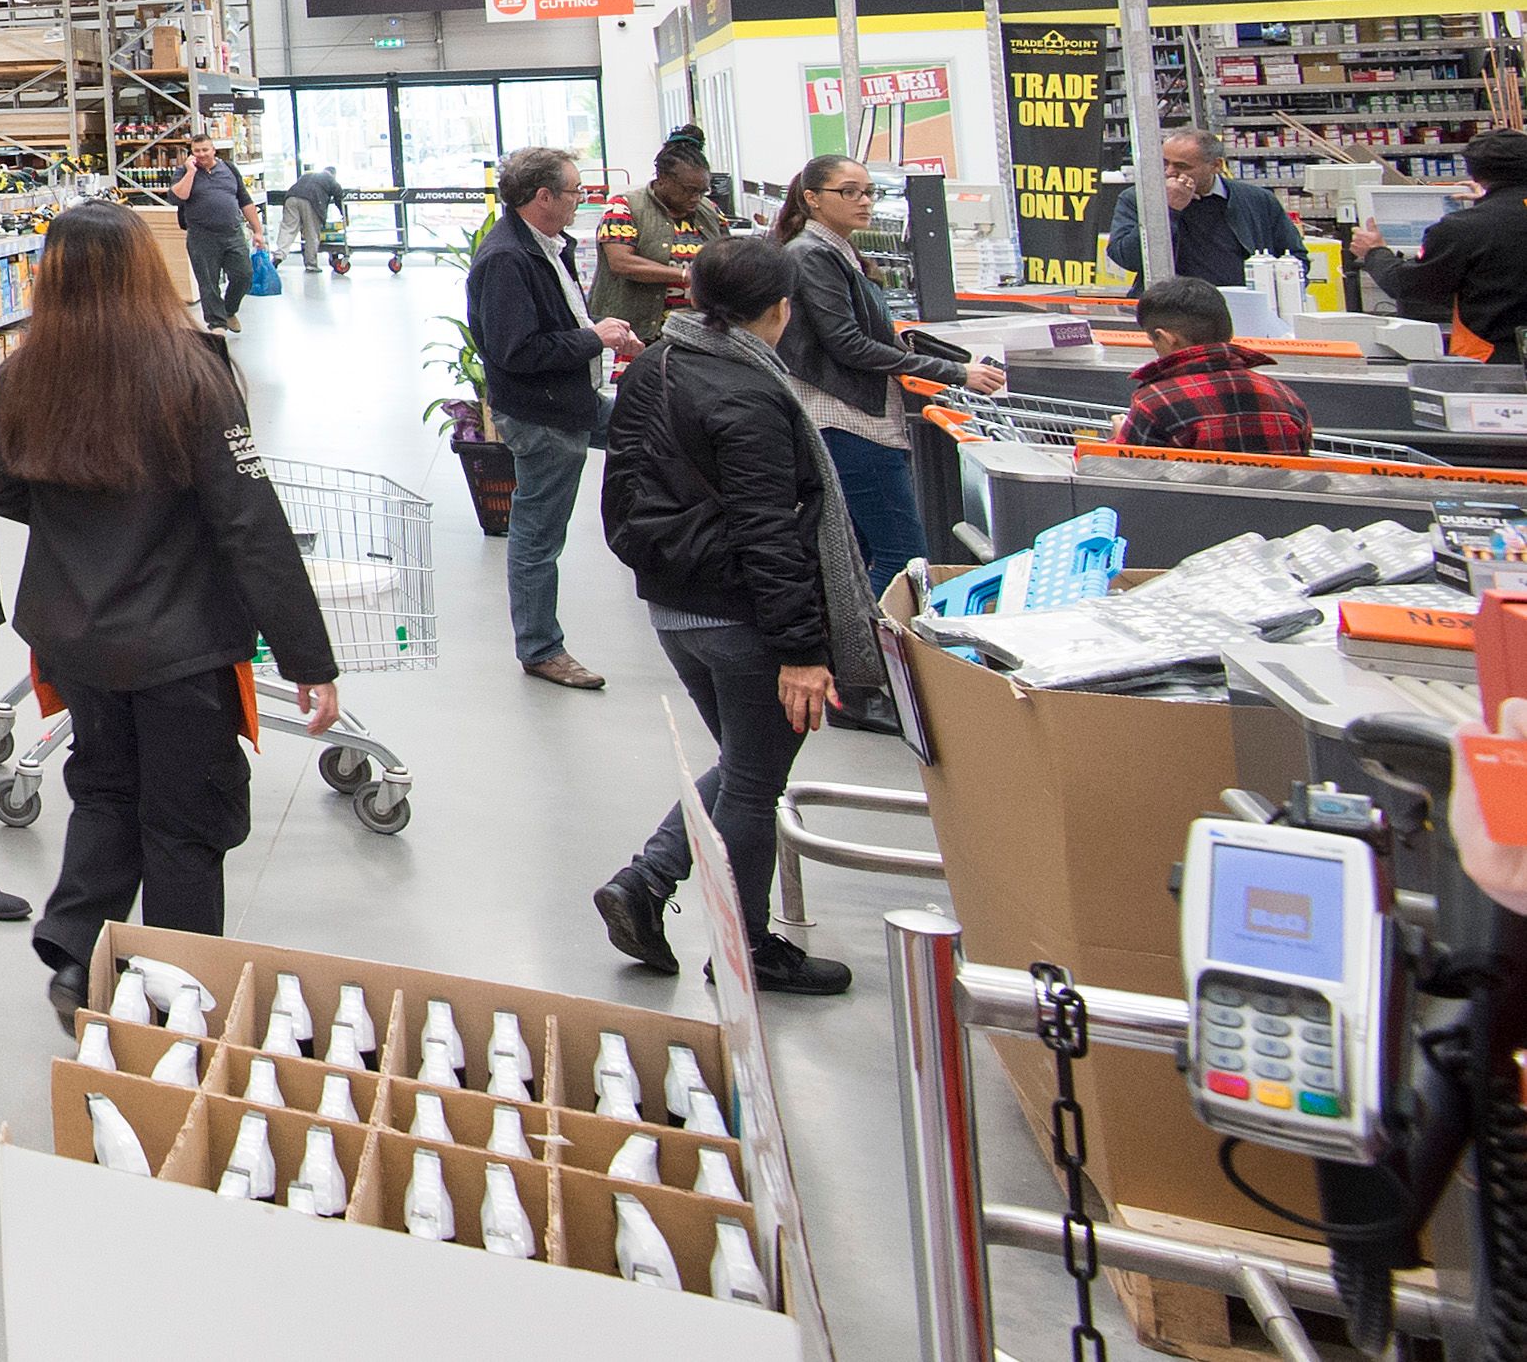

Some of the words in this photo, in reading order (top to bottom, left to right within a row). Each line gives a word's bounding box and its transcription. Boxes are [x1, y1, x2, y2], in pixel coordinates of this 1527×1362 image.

[1010, 39, 1044, 48] TRADE
[1064, 39, 1098, 48] POINT
[864, 76, 892, 95] THE
[896, 71, 936, 90] BEST
[1010, 73, 1098, 100] TRADE
[1018, 102, 1090, 129] ONLY
[1013, 165, 1098, 193] TRADE
[1020, 193, 1090, 222] ONLY
[1438, 515, 1510, 528] DURACELL
